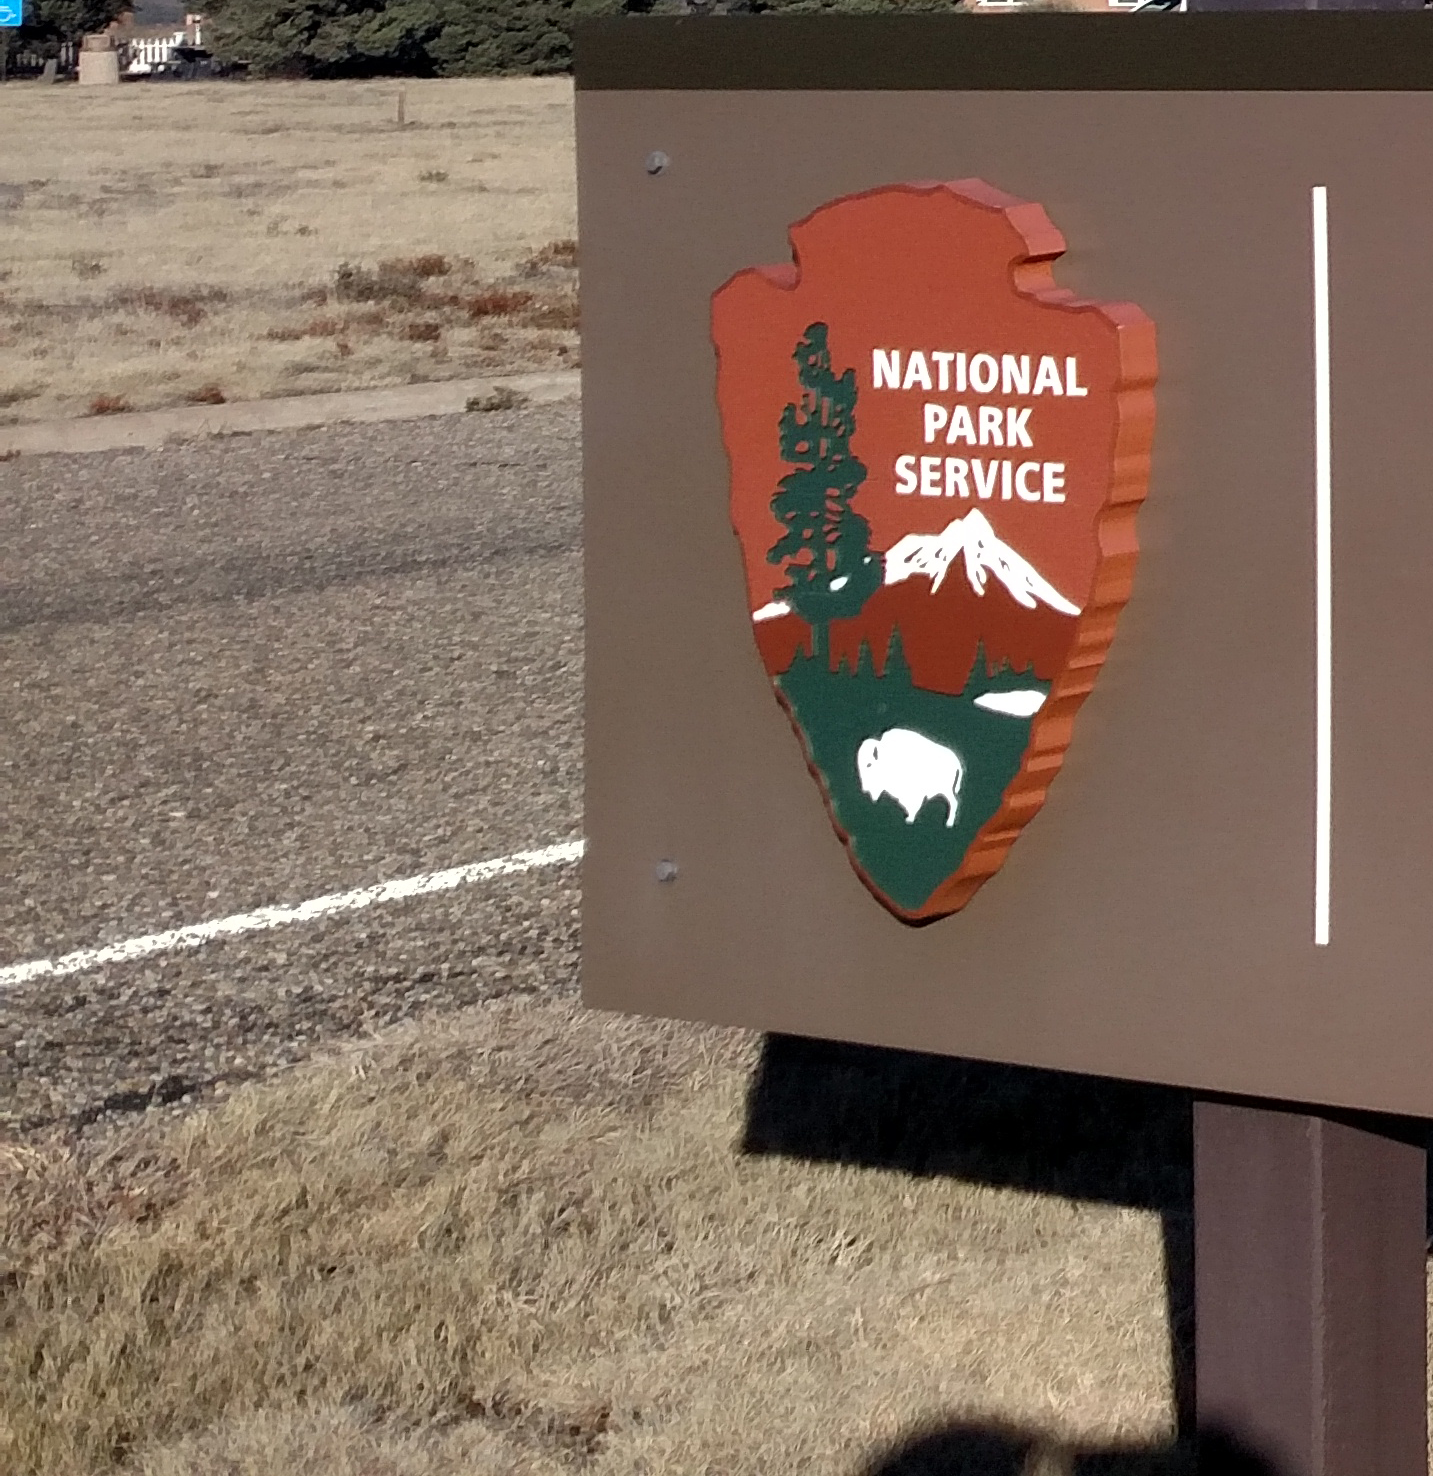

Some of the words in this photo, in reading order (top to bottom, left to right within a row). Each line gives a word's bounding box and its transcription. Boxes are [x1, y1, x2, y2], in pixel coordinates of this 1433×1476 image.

[871, 347, 1089, 398] NATIONAL
[923, 402, 1035, 449] PARK
[894, 454, 1067, 504] SERVICE
